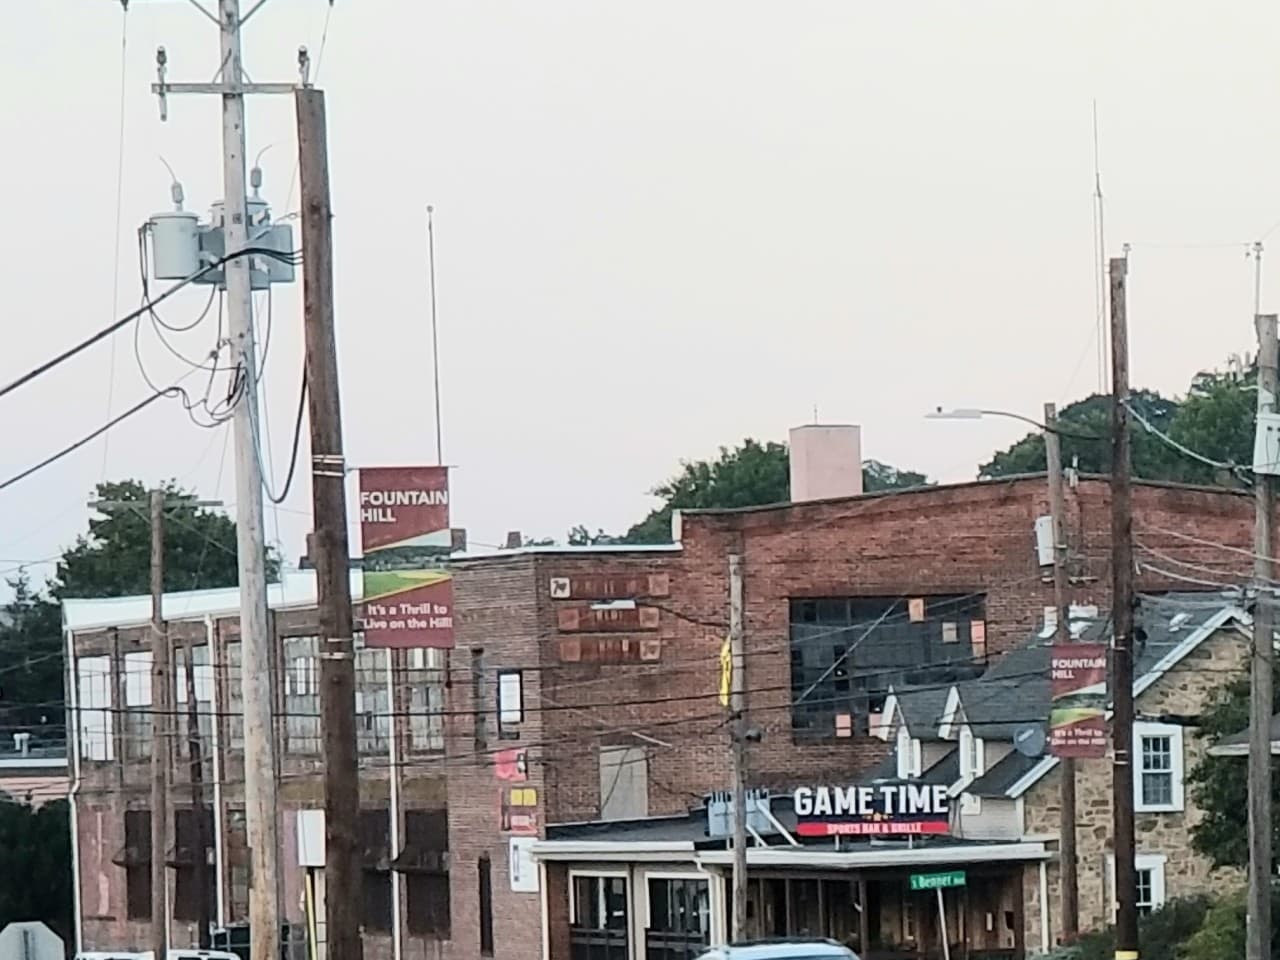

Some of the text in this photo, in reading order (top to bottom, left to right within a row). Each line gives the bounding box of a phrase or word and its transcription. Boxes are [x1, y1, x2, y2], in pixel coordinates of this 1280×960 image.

[360, 490, 448, 506] FOUNTAIN
[361, 508, 397, 522] HILL
[368, 603, 447, 615] It's a Thrill to
[363, 618, 387, 629] Live
[390, 620, 405, 629] on
[407, 618, 427, 629] the
[1052, 658, 1106, 669] FOUNTAIN
[1052, 670, 1074, 679] HILL
[794, 784, 949, 816] GAME TIME
[827, 823, 860, 835] SPORTS
[862, 822, 880, 834] BAR
